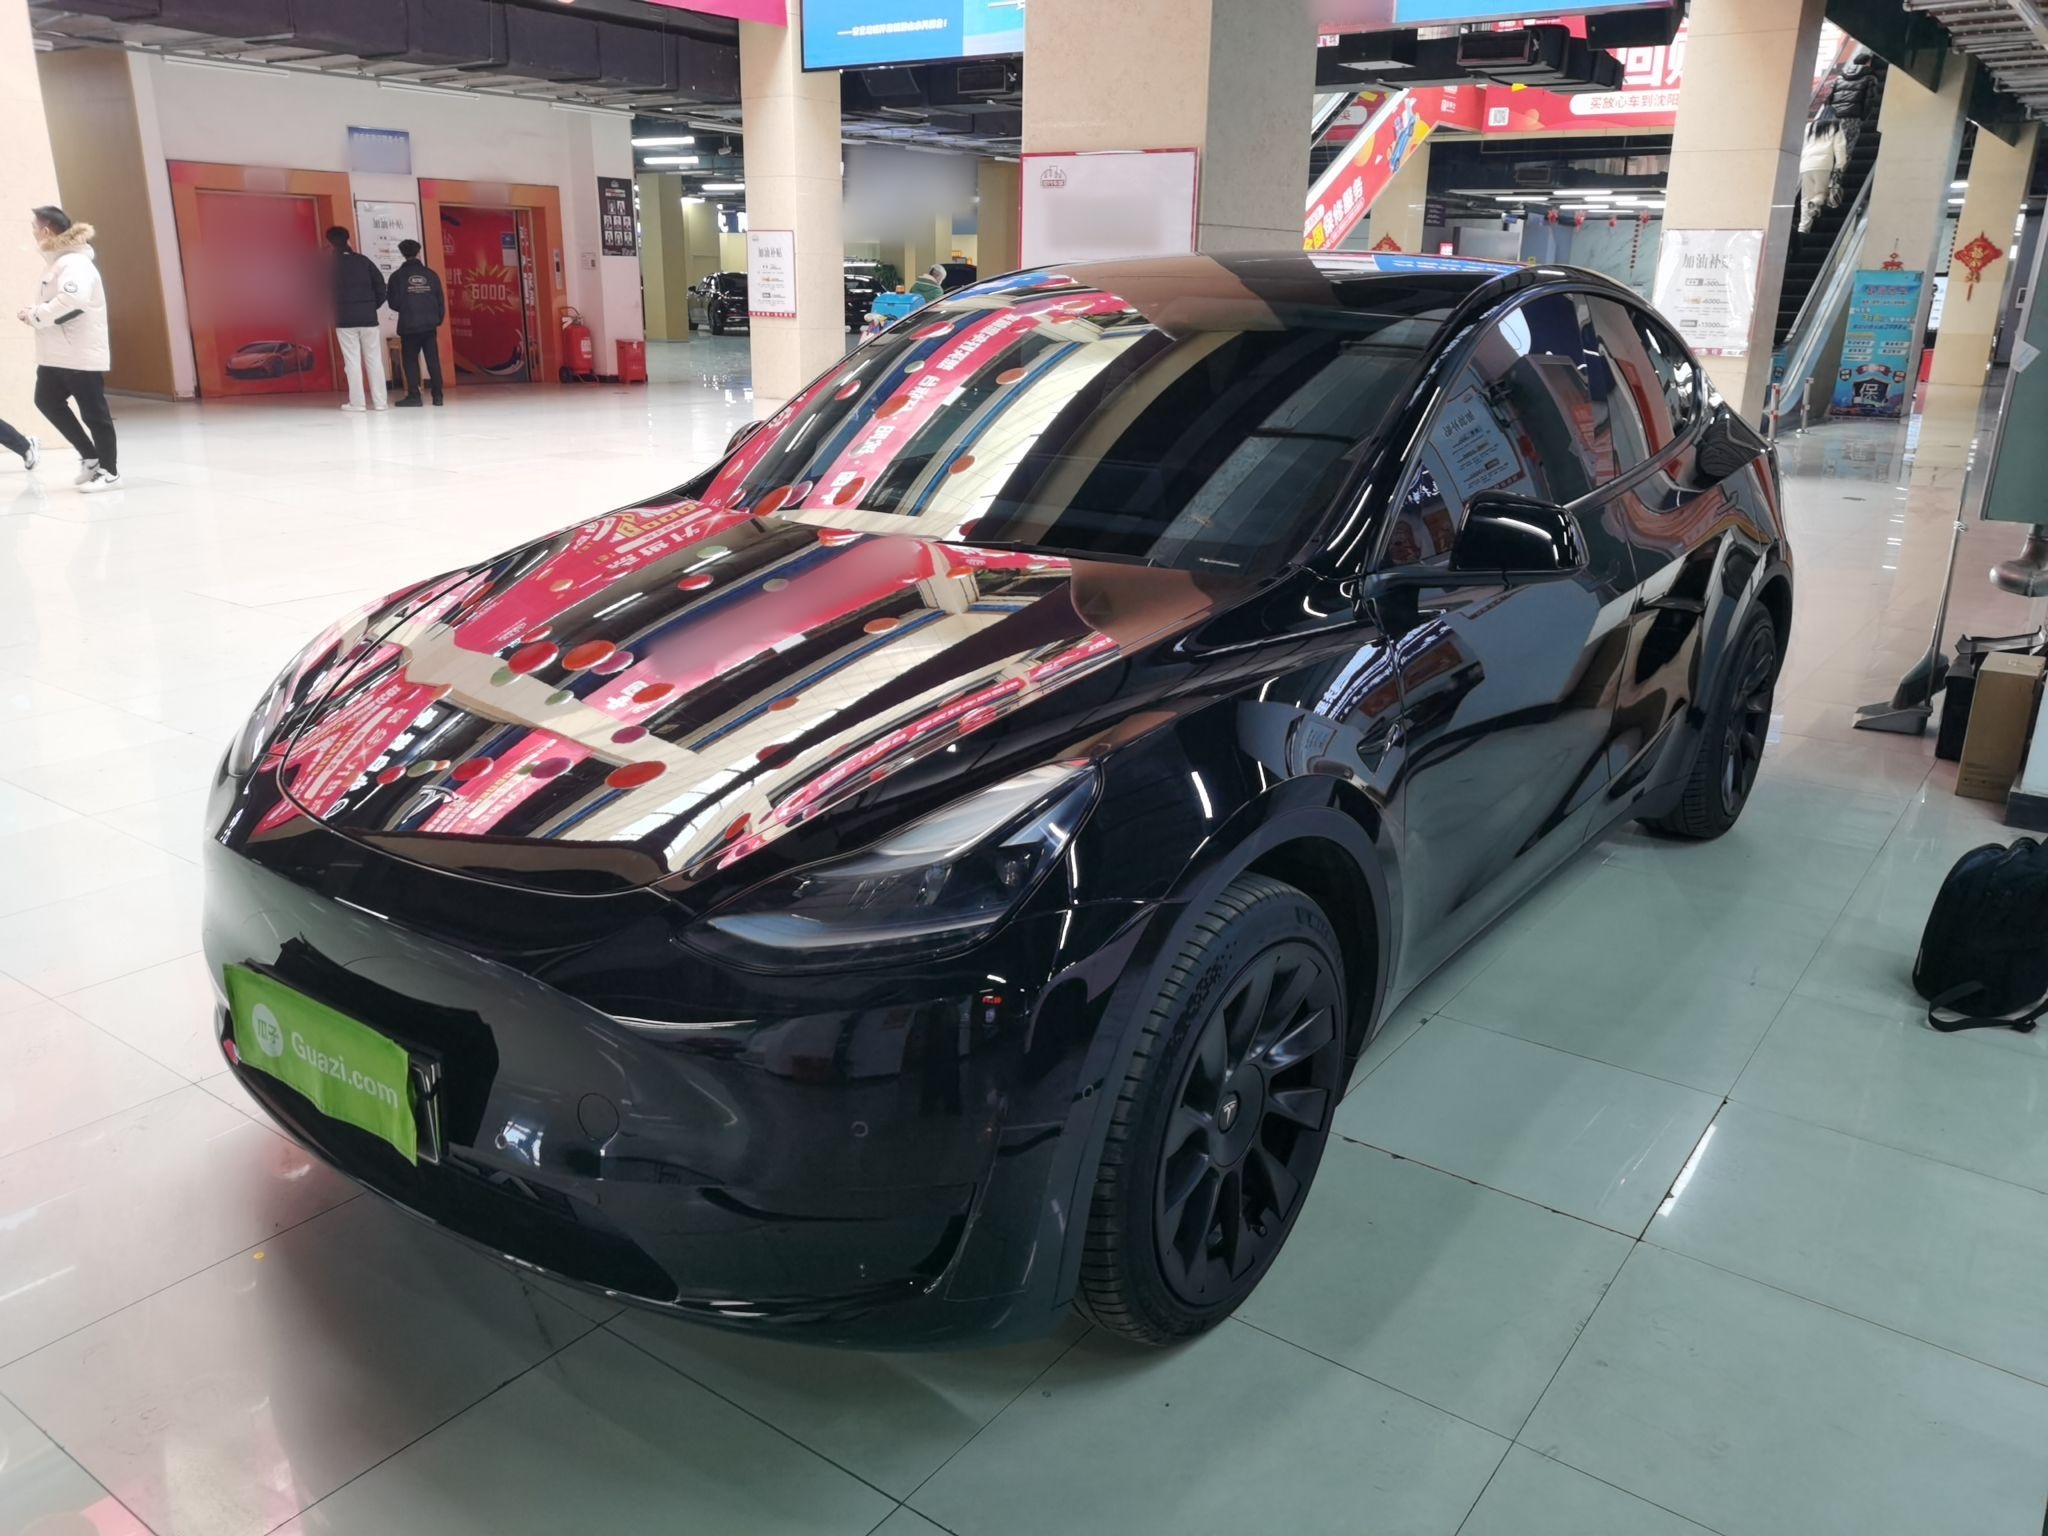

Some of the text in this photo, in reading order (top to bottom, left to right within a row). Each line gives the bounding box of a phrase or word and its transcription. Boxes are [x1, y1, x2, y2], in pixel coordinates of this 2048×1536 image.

[1590, 93, 1680, 110] 买放心车到沈阳
[471, 283, 506, 300] 6000
[290, 1030, 400, 1109] Guazi.com
